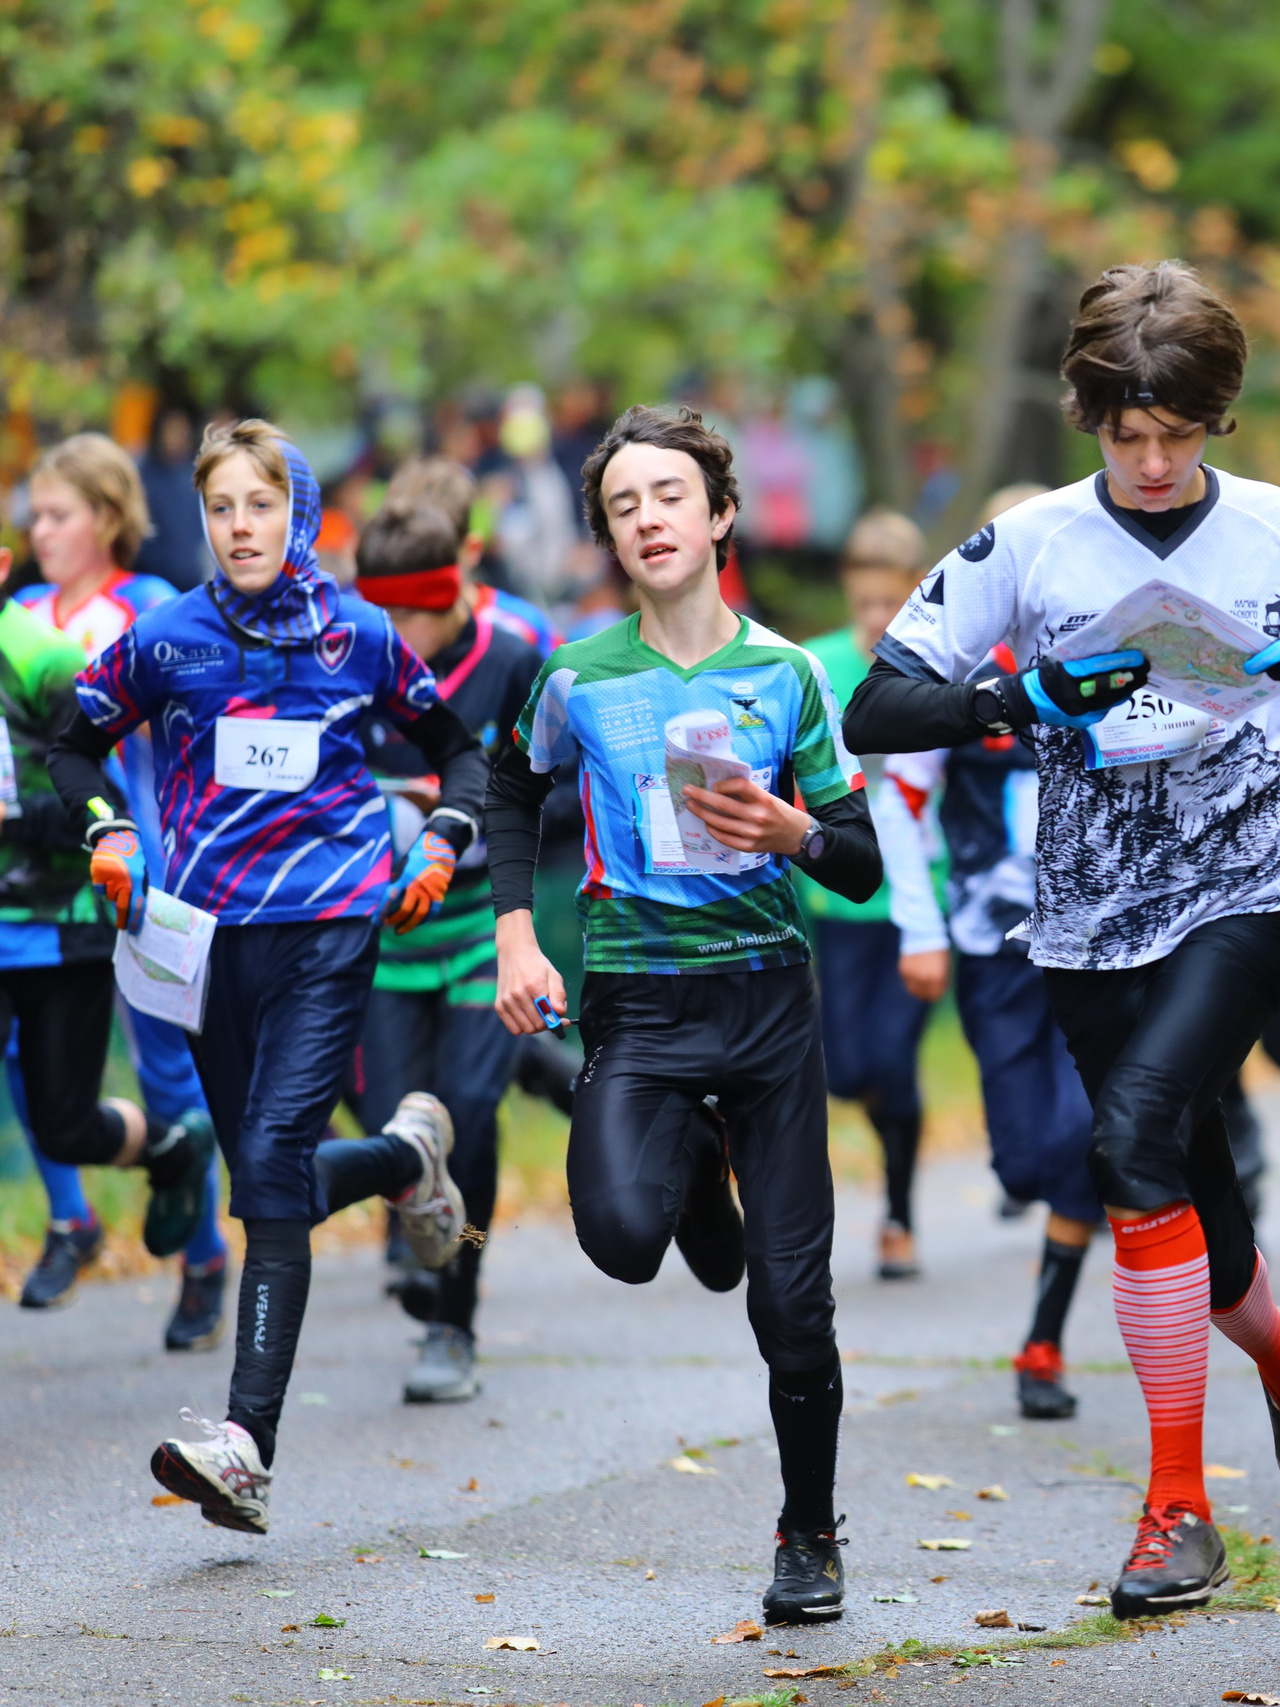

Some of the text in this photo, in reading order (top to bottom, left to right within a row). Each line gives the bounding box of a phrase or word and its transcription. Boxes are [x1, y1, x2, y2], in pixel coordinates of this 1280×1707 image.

[1126, 694, 1174, 721] 250
[1151, 719, 1197, 732] 3 линия
[245, 744, 289, 768] 267
[1138, 743, 1164, 754] РОССИИ
[253, 1284, 269, 1353] ARSWEAR
